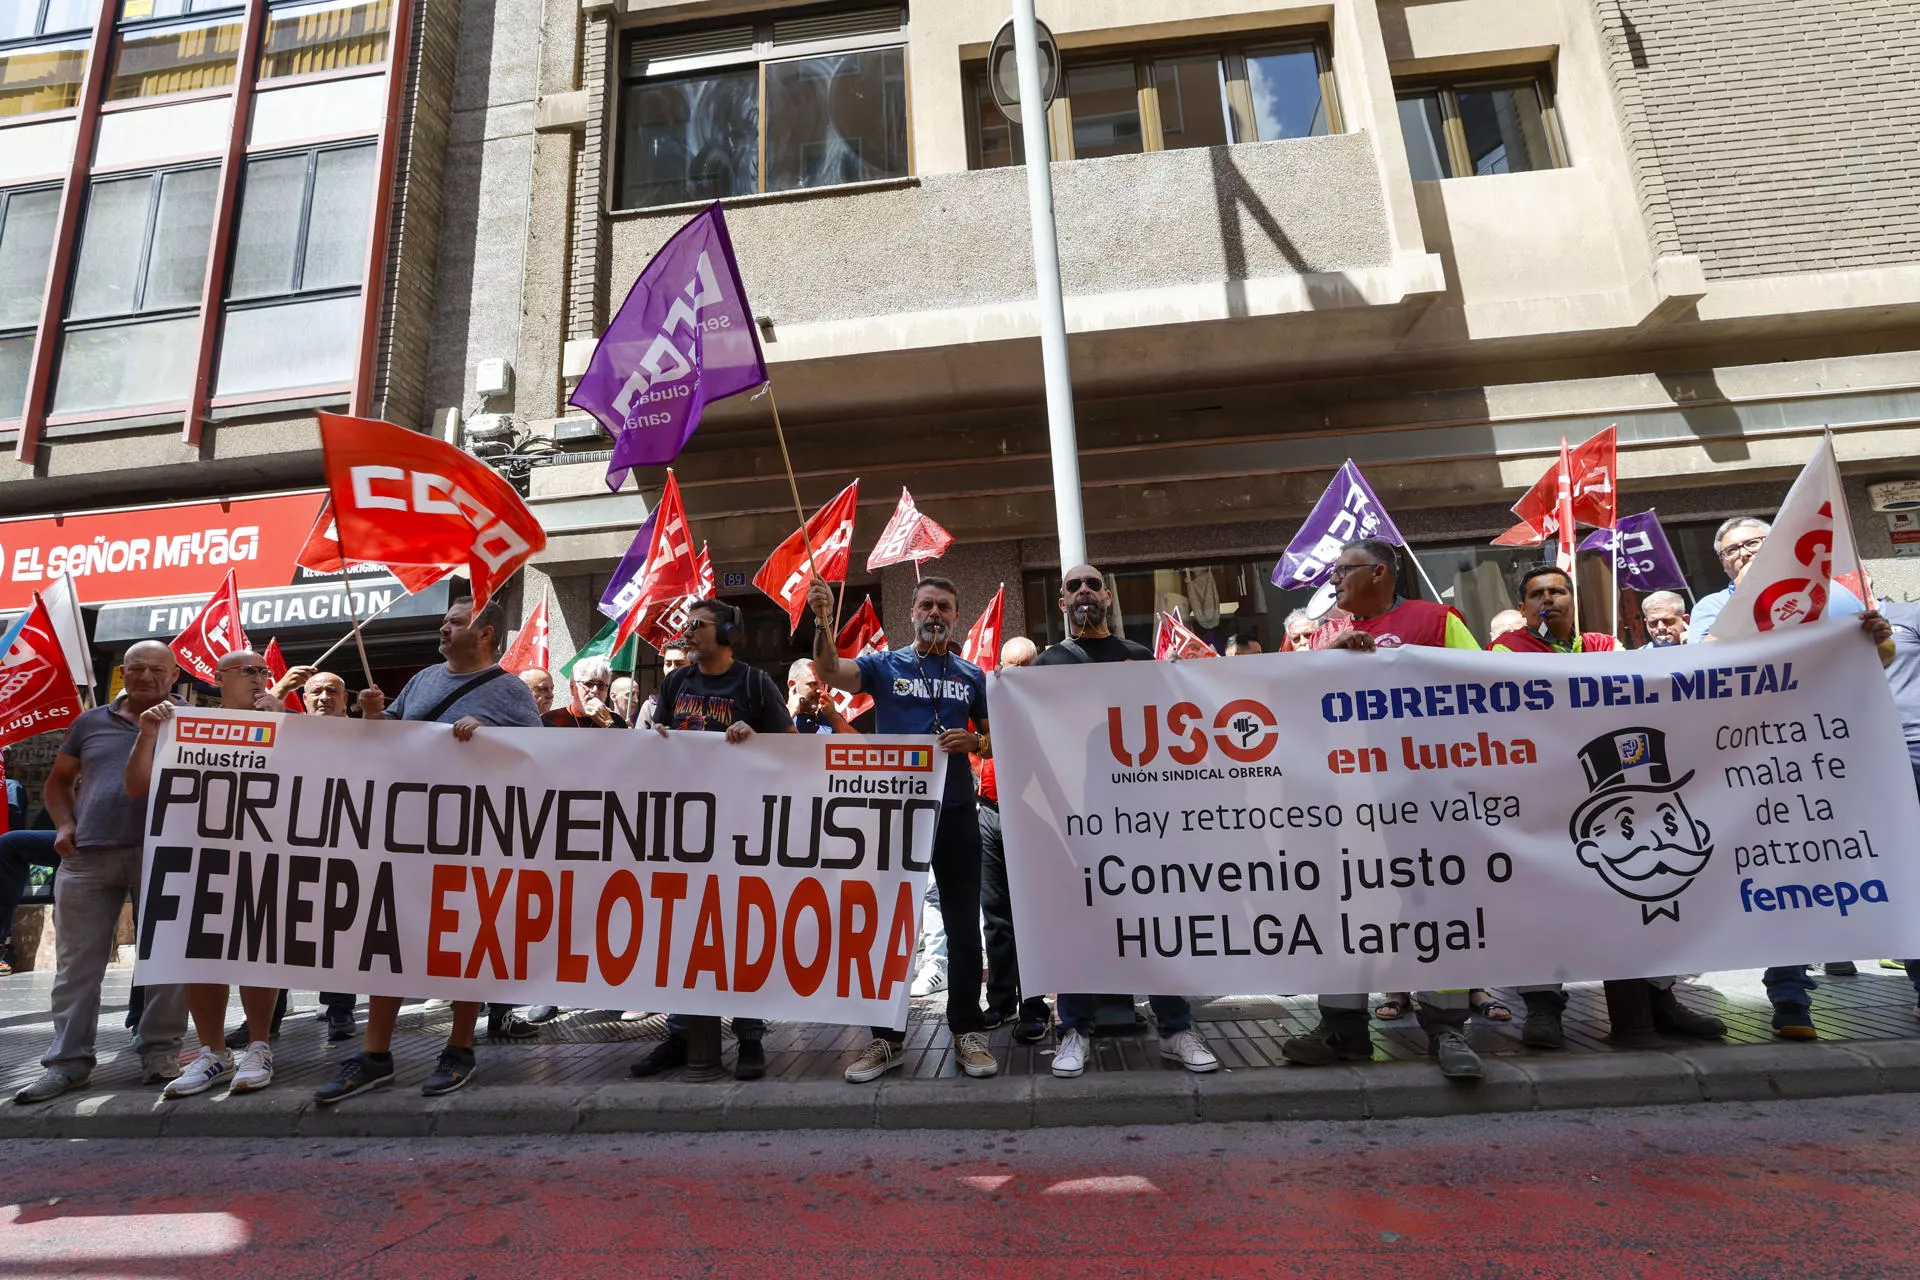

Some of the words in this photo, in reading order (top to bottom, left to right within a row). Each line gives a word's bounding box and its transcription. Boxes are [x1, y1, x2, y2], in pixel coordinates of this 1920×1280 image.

[12, 547, 45, 581] EL
[728, 573, 742, 586] 89
[147, 589, 392, 632] FINCIACION
[1321, 679, 1554, 723] OBREROS
[1568, 673, 1659, 709] DEL
[1669, 662, 1799, 702] METAL
[180, 721, 246, 741] CCOO
[1107, 698, 1279, 768] USO
[1813, 713, 1850, 740] la
[177, 746, 266, 769] Industria
[830, 749, 899, 766] CCOO
[1327, 746, 1388, 774] en
[1401, 732, 1538, 771] lucha
[1724, 756, 1802, 788] mala
[1811, 752, 1846, 780] fe
[828, 774, 928, 794] Industria
[1111, 769, 1158, 784] UNIÓN
[1162, 768, 1225, 782] SINDICAL
[1228, 766, 1282, 779] OBRERA
[149, 768, 280, 842] POR
[287, 775, 375, 850] UN
[384, 780, 717, 864] CONVENIO
[732, 794, 942, 873] JUSTO
[1066, 814, 1103, 836] no
[1115, 806, 1170, 839] hay
[1181, 803, 1343, 832] retroceso
[1356, 800, 1419, 832] que
[1430, 791, 1521, 826] valga
[1755, 797, 1789, 825] de
[1796, 794, 1834, 822] la
[1735, 830, 1878, 874] patronal
[1083, 850, 1321, 907] ¡Convenio
[1340, 847, 1466, 902] justo
[1486, 851, 1513, 884] o
[1740, 878, 1889, 917] femepa
[138, 846, 403, 974] FEMEPA
[426, 863, 915, 1000] EXPLOTADORA
[1115, 913, 1323, 959] HUELGA
[1341, 906, 1487, 964] larga!
